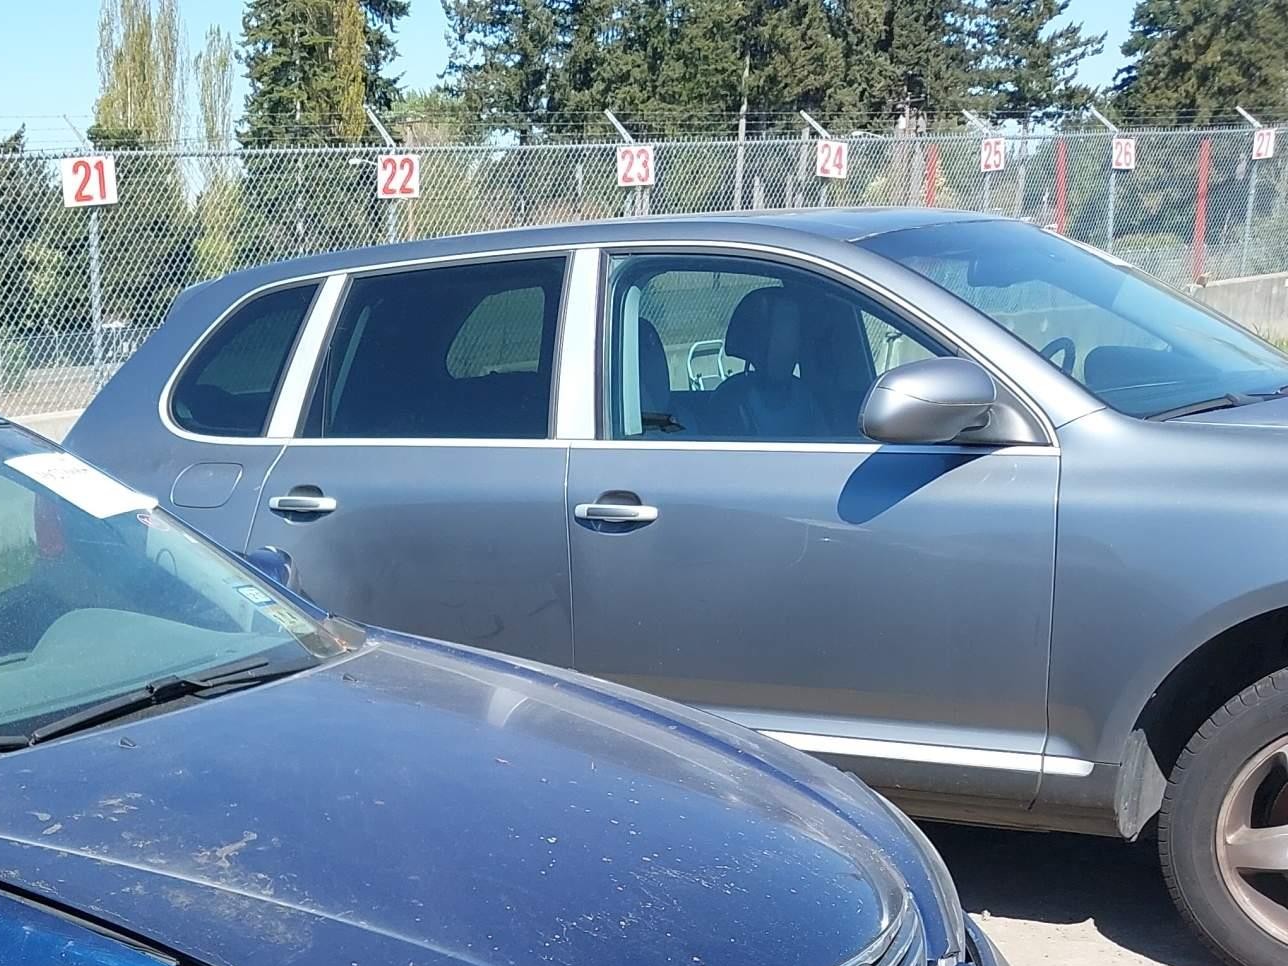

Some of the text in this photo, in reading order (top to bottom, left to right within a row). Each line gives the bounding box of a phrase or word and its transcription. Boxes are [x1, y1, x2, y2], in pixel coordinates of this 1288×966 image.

[820, 143, 844, 175] 24
[983, 142, 1002, 170] 25
[1114, 142, 1132, 167] 26
[1256, 133, 1272, 158] 27
[72, 158, 108, 203] 21
[380, 157, 415, 196] 22
[621, 149, 651, 183] 23
